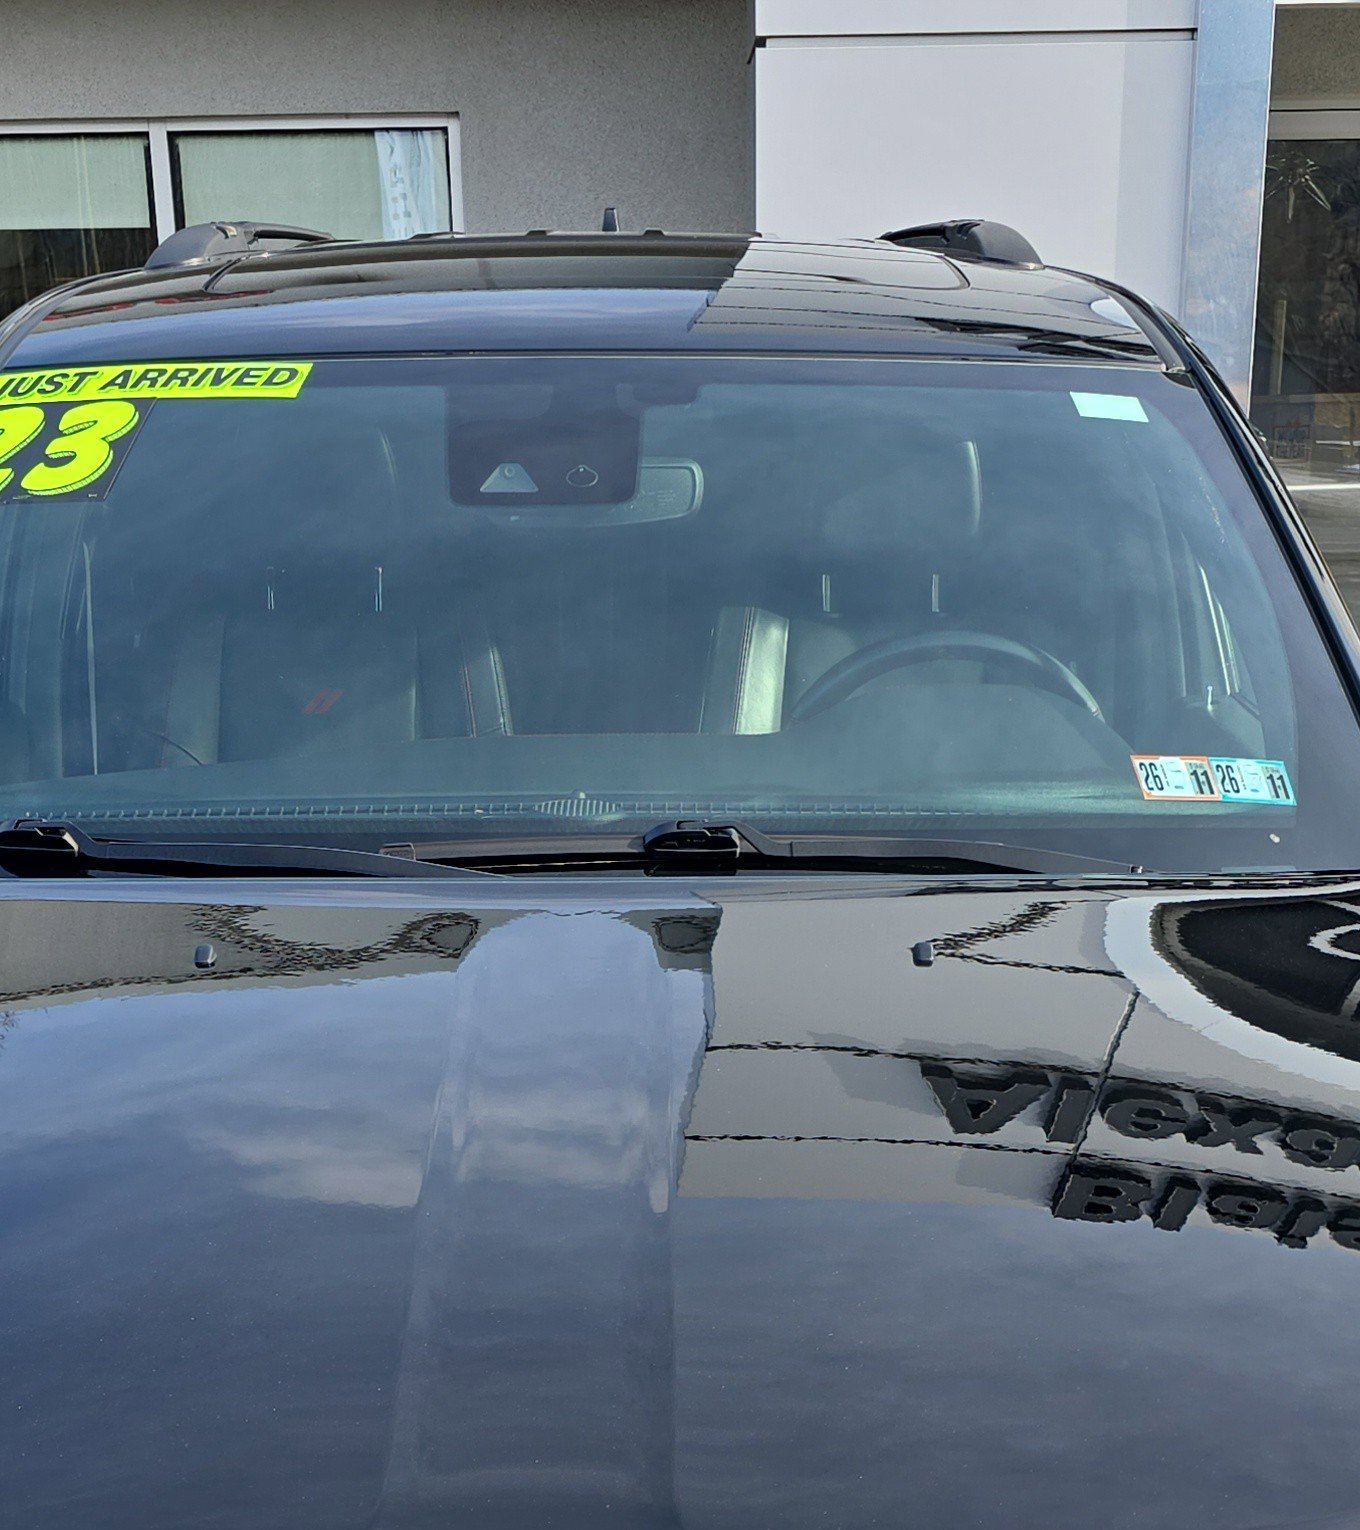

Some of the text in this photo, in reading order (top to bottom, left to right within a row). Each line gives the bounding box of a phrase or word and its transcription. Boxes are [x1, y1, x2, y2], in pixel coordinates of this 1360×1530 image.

[101, 367, 301, 392] ARRIVED
[1139, 762, 1165, 791] 26
[1190, 769, 1215, 796] 11
[1215, 764, 1240, 794] 26
[1267, 773, 1291, 800] 11
